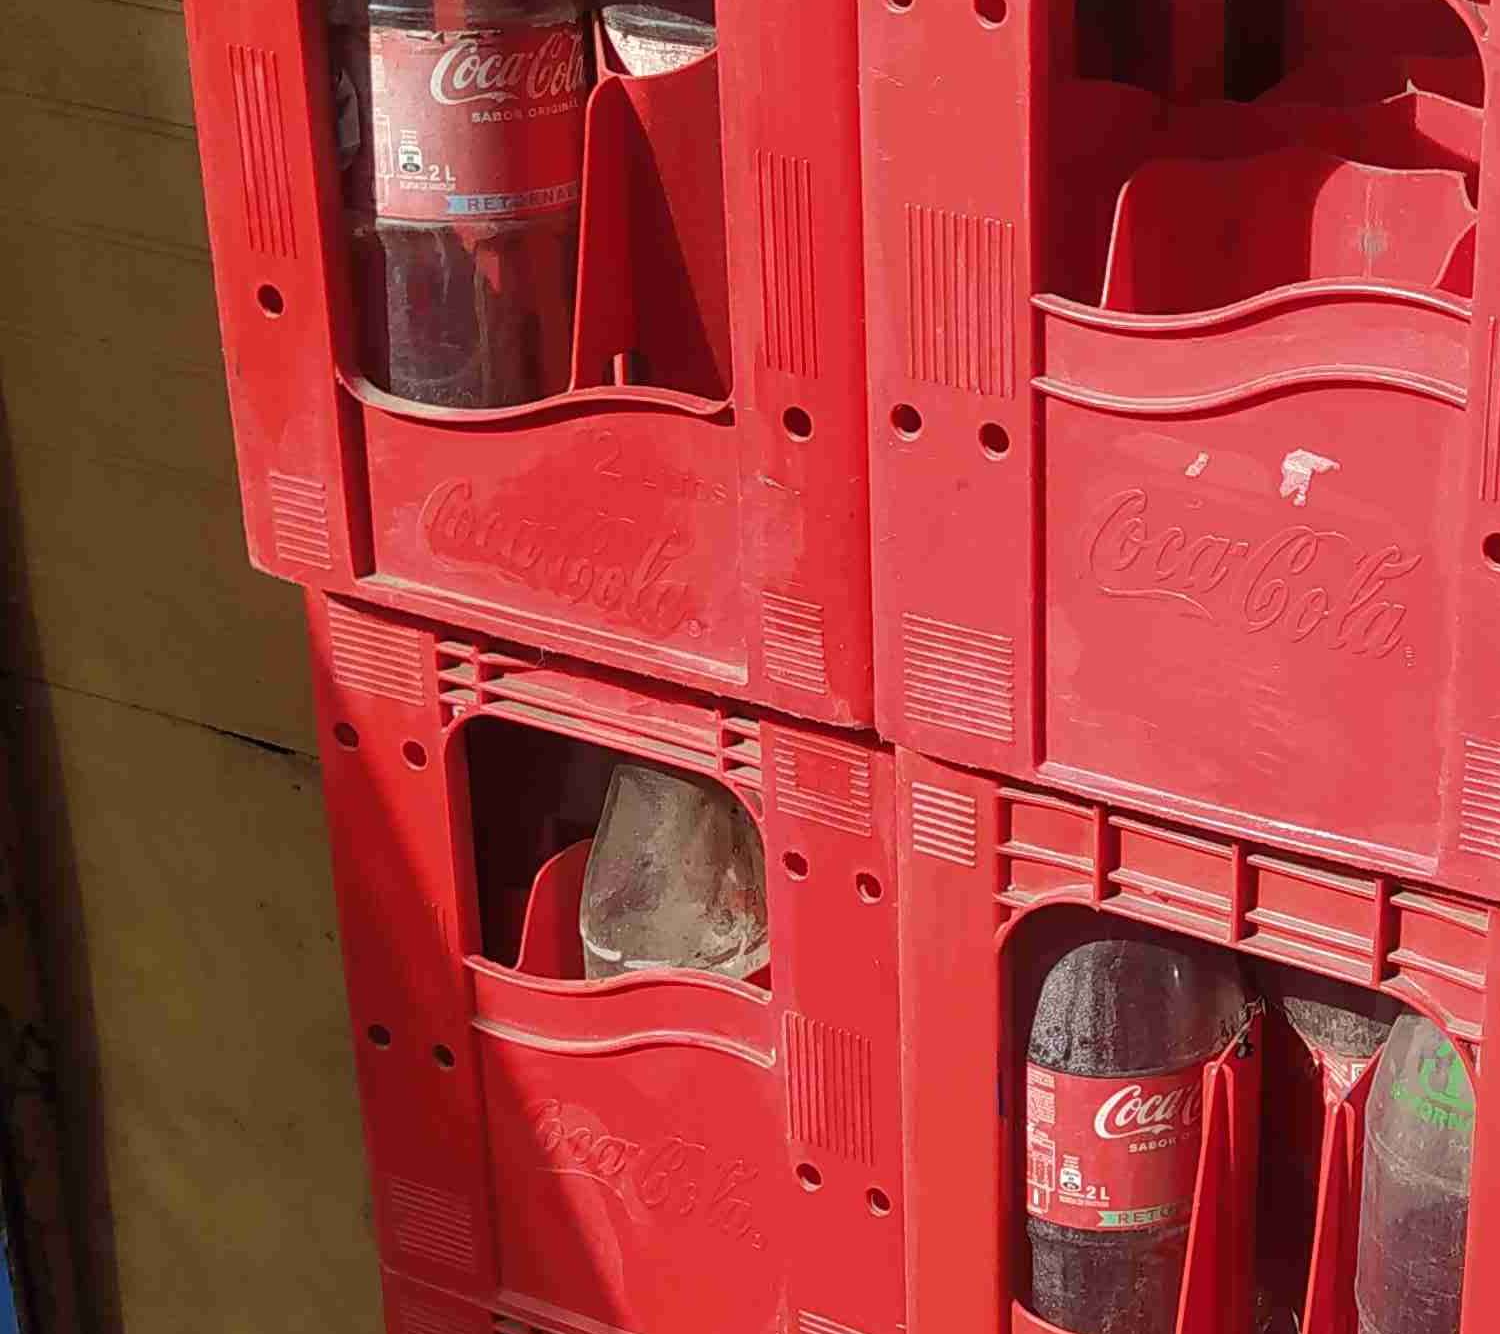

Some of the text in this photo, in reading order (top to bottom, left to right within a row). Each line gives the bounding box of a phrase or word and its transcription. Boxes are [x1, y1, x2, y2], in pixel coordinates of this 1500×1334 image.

[429, 164, 457, 181] 2 L
[1089, 487, 1423, 661] Coca-Cola
[1086, 1185, 1111, 1201] 2 L
